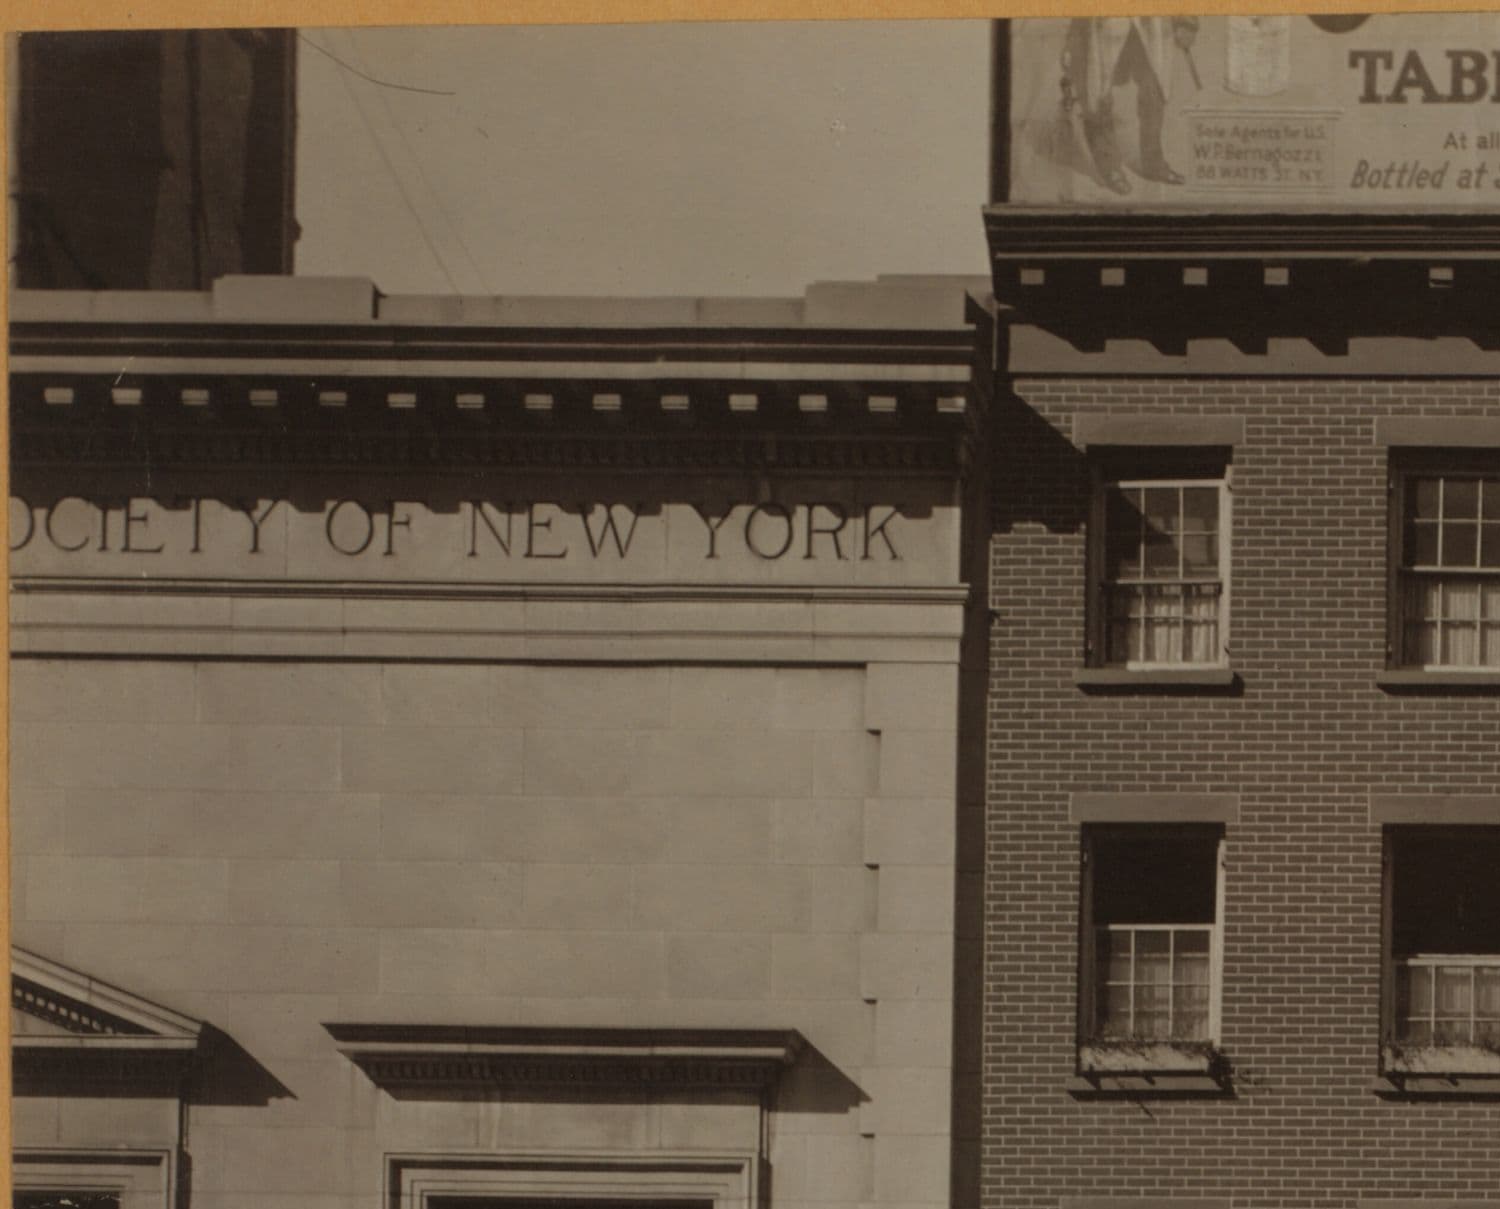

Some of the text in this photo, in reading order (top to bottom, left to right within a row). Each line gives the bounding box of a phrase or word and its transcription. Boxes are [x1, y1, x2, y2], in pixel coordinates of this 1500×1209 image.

[1441, 130, 1467, 152] At
[1475, 130, 1500, 151] all
[1350, 160, 1447, 191] Bottled
[1457, 161, 1488, 190] at
[323, 497, 414, 558] OF
[466, 499, 648, 561] NEW
[693, 501, 906, 563] YORK
